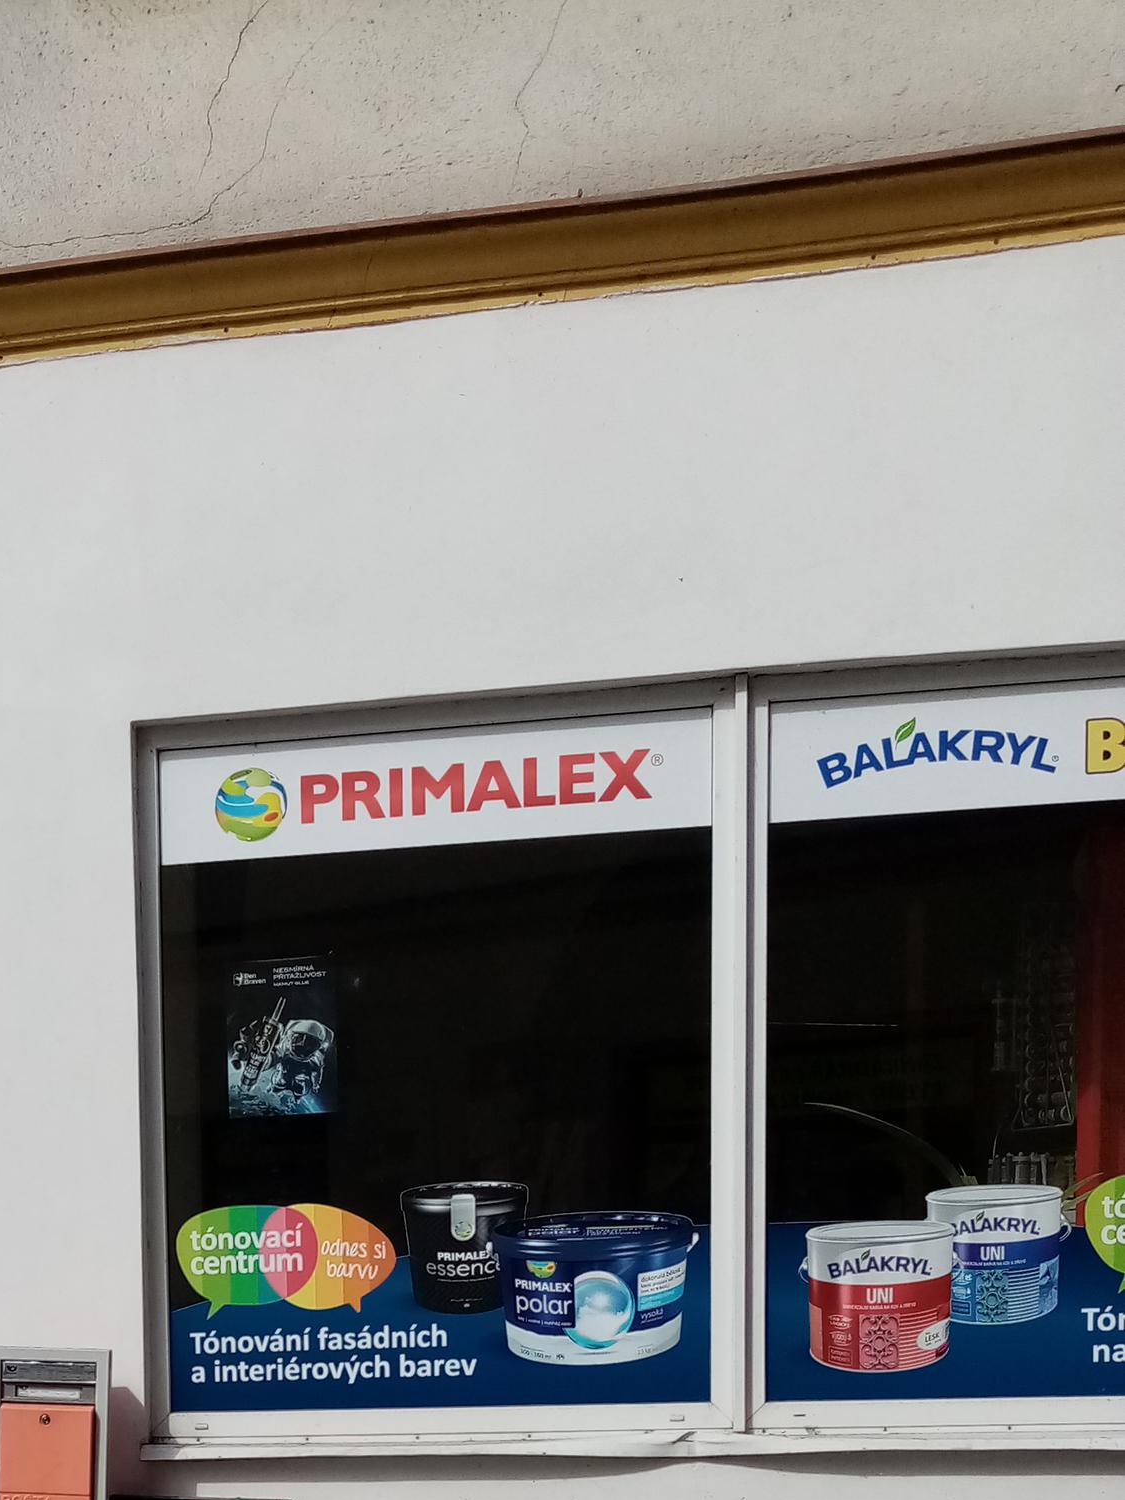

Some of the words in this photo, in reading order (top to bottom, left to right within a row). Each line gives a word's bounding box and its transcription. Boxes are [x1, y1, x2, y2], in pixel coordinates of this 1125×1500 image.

[300, 748, 653, 826] PRIMALEX
[190, 1222, 303, 1250] tónovací
[321, 1239, 367, 1258] odnes
[373, 1241, 386, 1260] si
[980, 1245, 1005, 1261] UNI
[190, 1251, 303, 1275] centrum
[326, 1260, 379, 1280] barvu
[514, 1278, 573, 1293] PRIMALEX
[866, 1288, 894, 1304] UNI
[515, 1294, 573, 1315] polar
[189, 1328, 311, 1354] Tónování
[317, 1323, 448, 1351] fasádních
[924, 1332, 940, 1343] LESK
[191, 1365, 206, 1383] a
[214, 1354, 391, 1384] interiérových
[399, 1353, 477, 1378] barev
